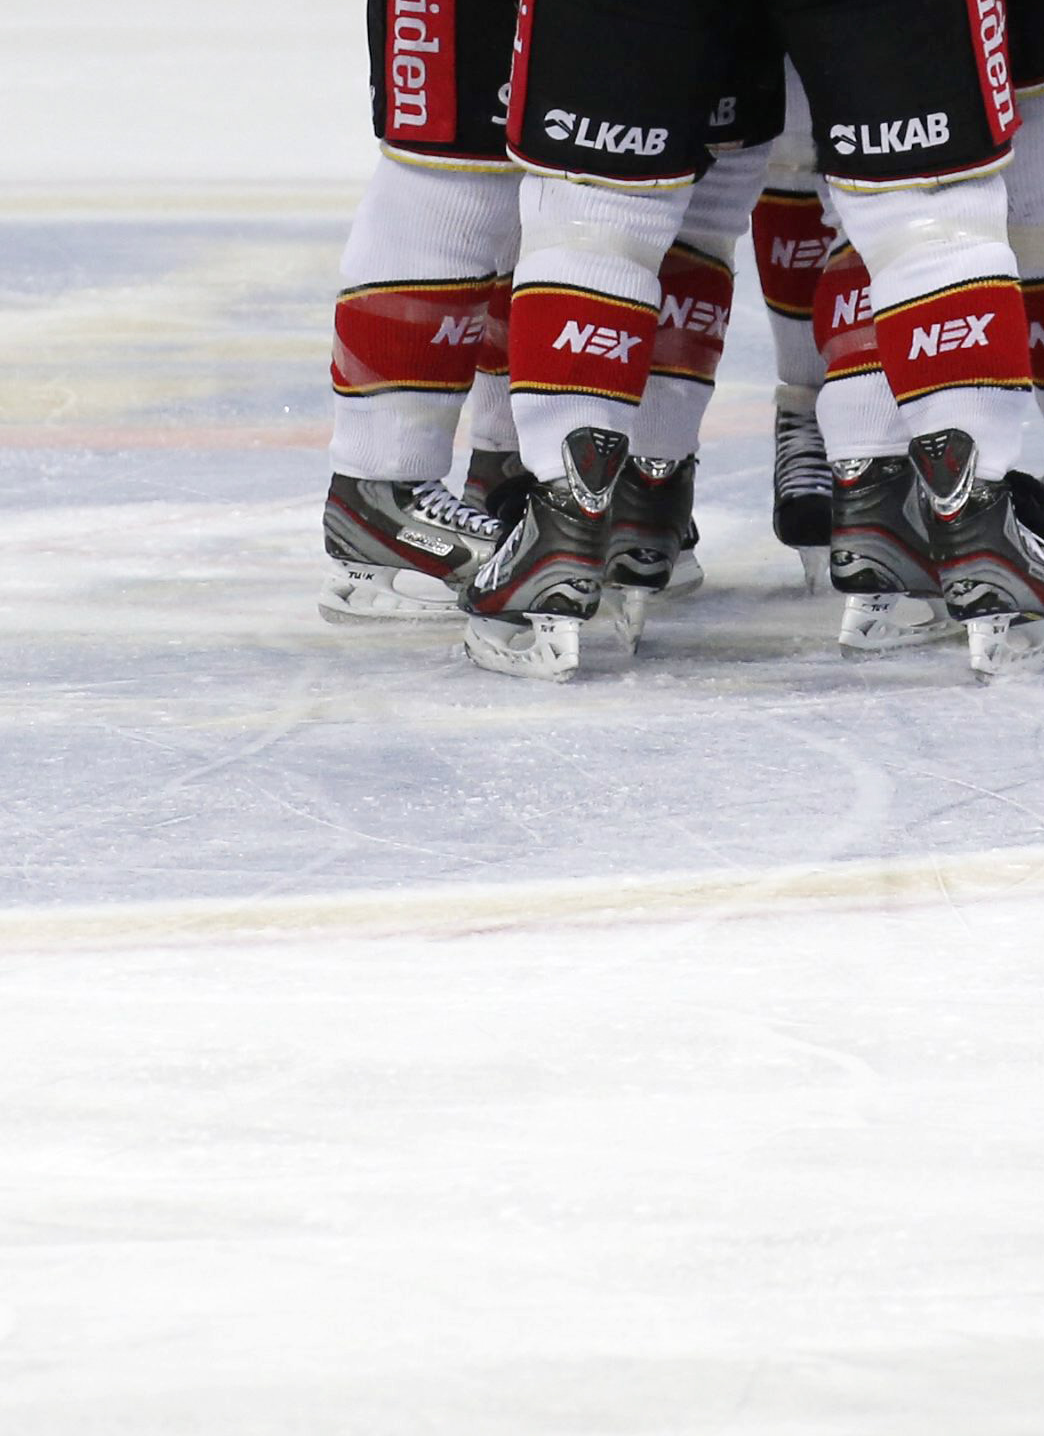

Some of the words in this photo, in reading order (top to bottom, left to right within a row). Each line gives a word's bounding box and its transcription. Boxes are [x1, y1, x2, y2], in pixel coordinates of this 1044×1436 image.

[574, 117, 669, 156] LKAB
[861, 112, 950, 155] LKAB
[552, 319, 643, 365] NEX
[908, 311, 996, 361] NEX
